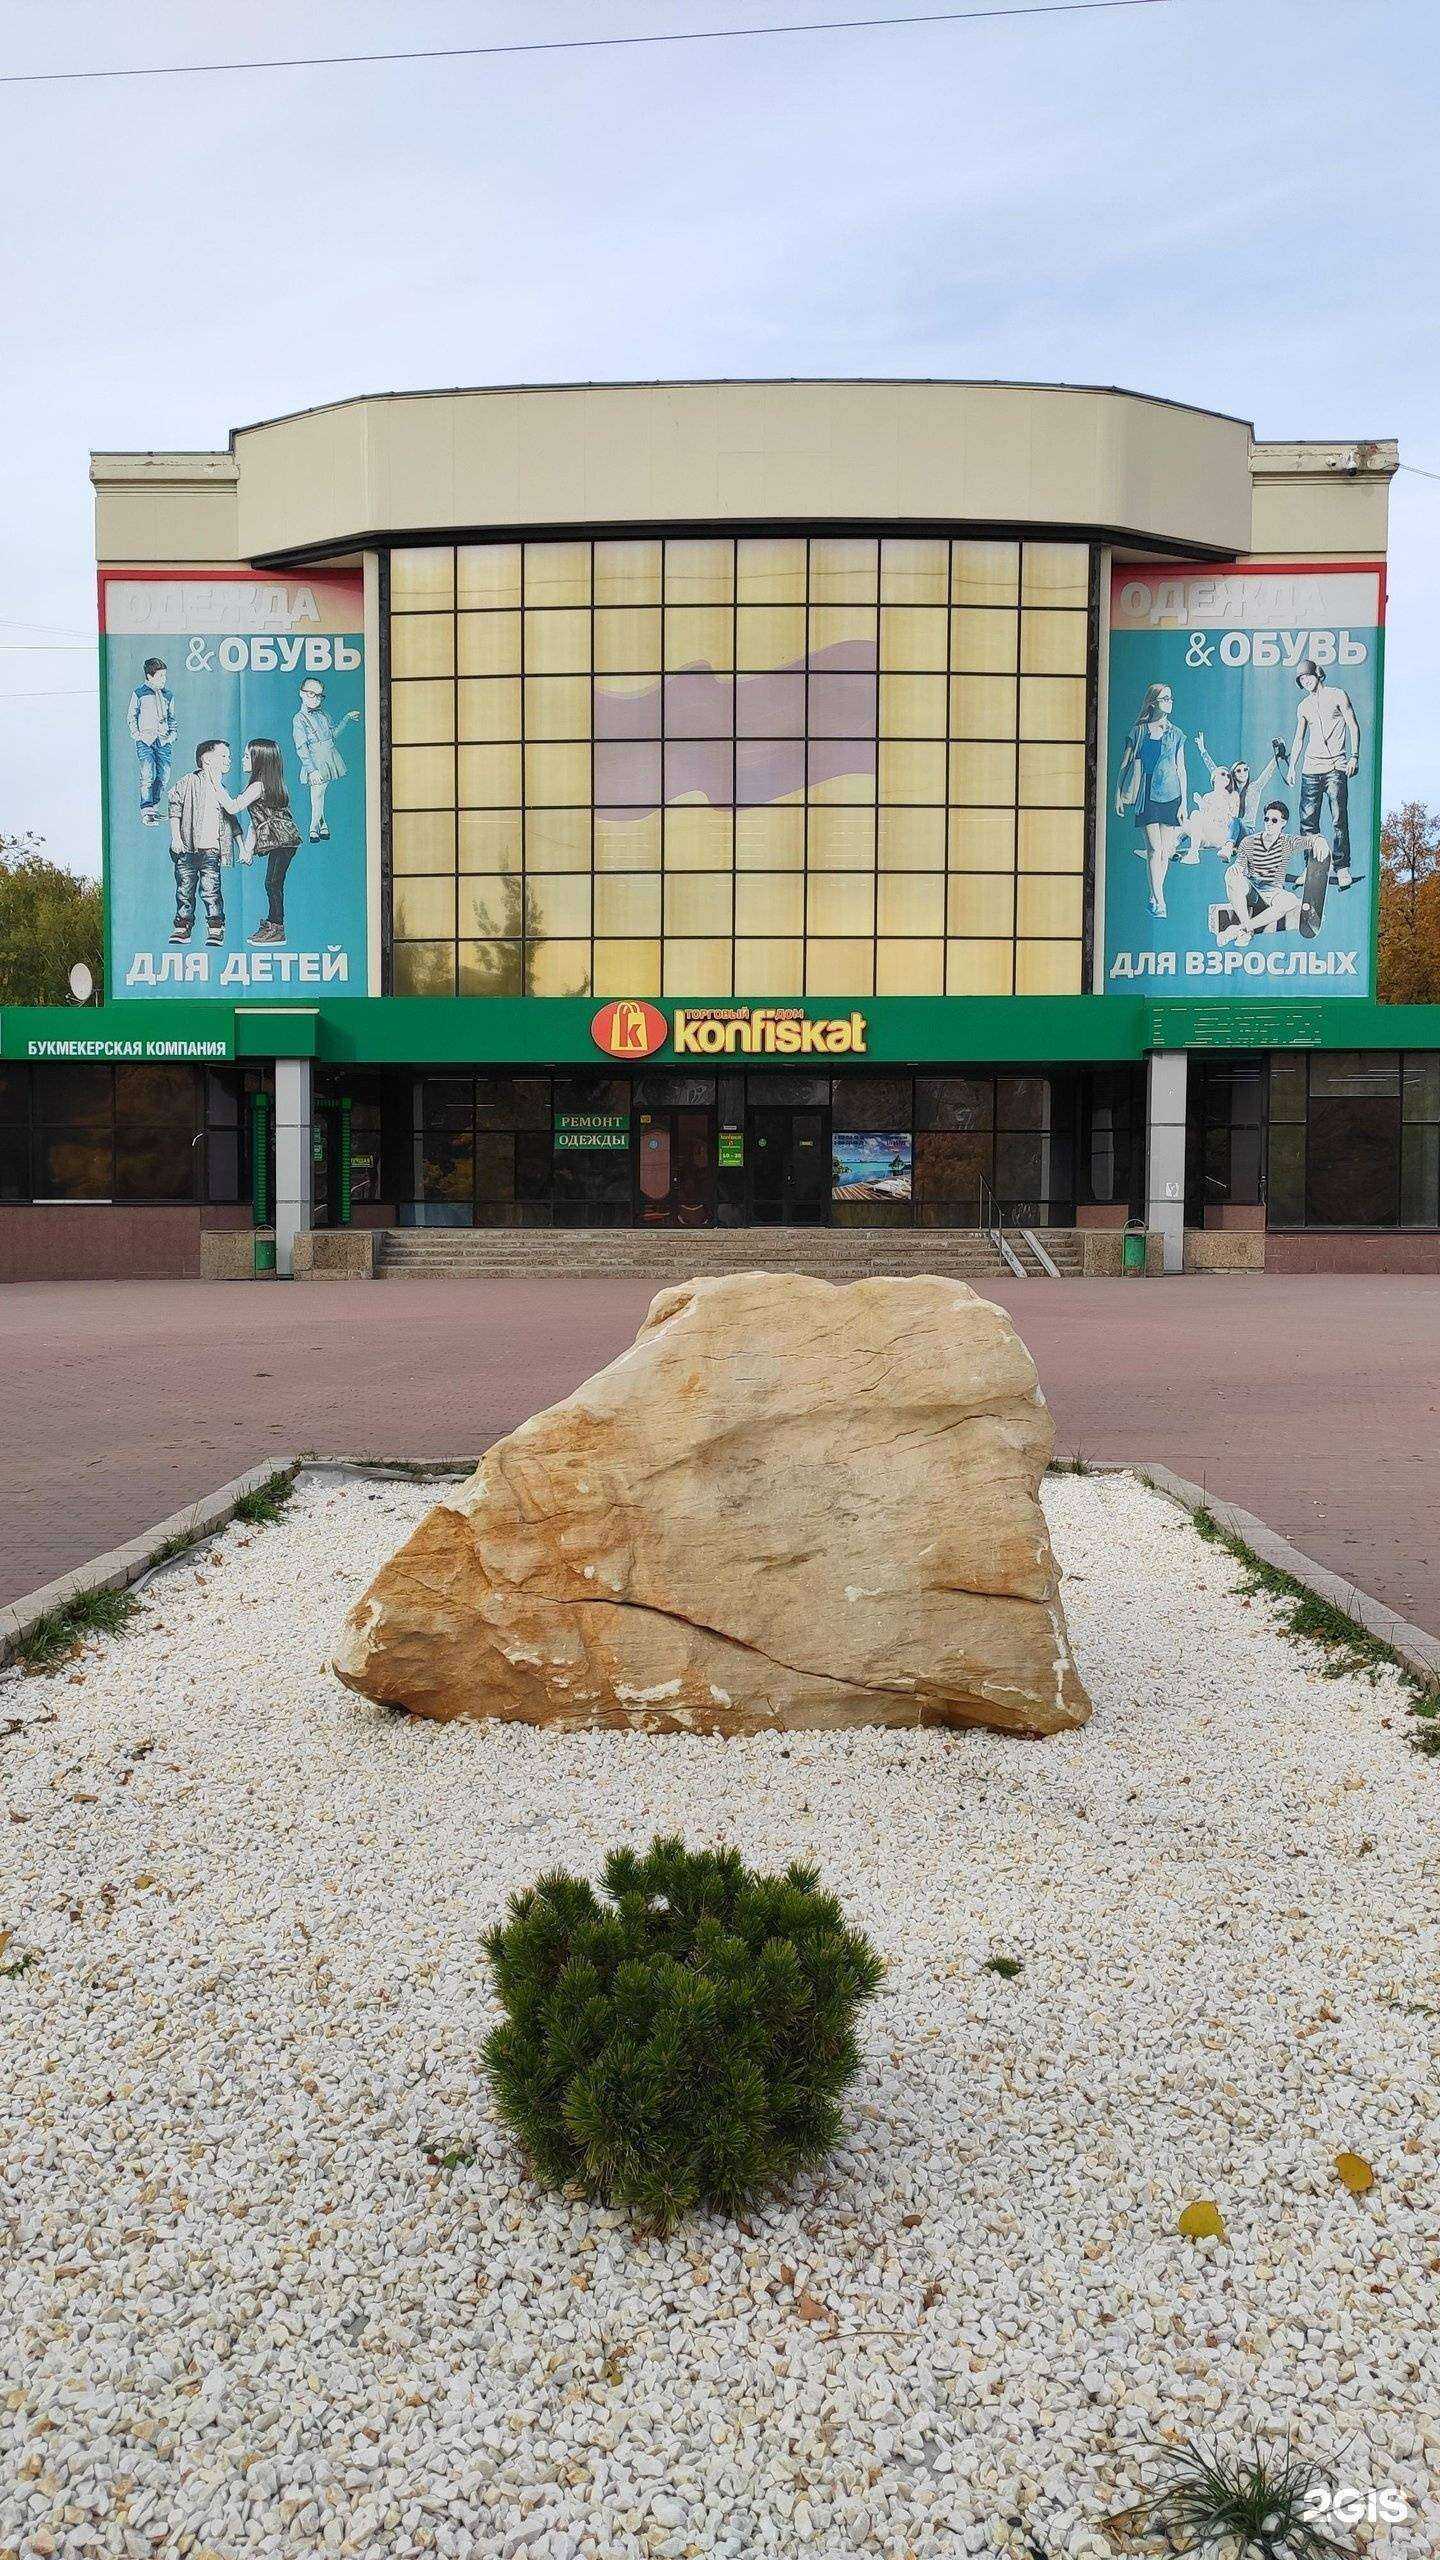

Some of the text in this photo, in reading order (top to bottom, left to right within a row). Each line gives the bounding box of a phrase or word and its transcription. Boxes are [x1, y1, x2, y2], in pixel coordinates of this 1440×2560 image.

[125, 585, 321, 630] ОДЕЖДА
[1119, 581, 1328, 626] ОДЕЖДА
[126, 944, 350, 987] ДЛЯ ДЕТЕЙ
[1110, 950, 1359, 979] ДЛЯ ВЗРОСЛЫХ
[686, 1006, 804, 1020] ТОРГОВЫЙ ДОМ
[674, 1010, 867, 1053] konfiskat
[28, 1040, 226, 1056] БУКМЕКЕРСКАЯ КОМПАНИЯ
[561, 1116, 623, 1127] РЕМОНТ
[559, 1135, 626, 1147] ОДЕЖДЫ
